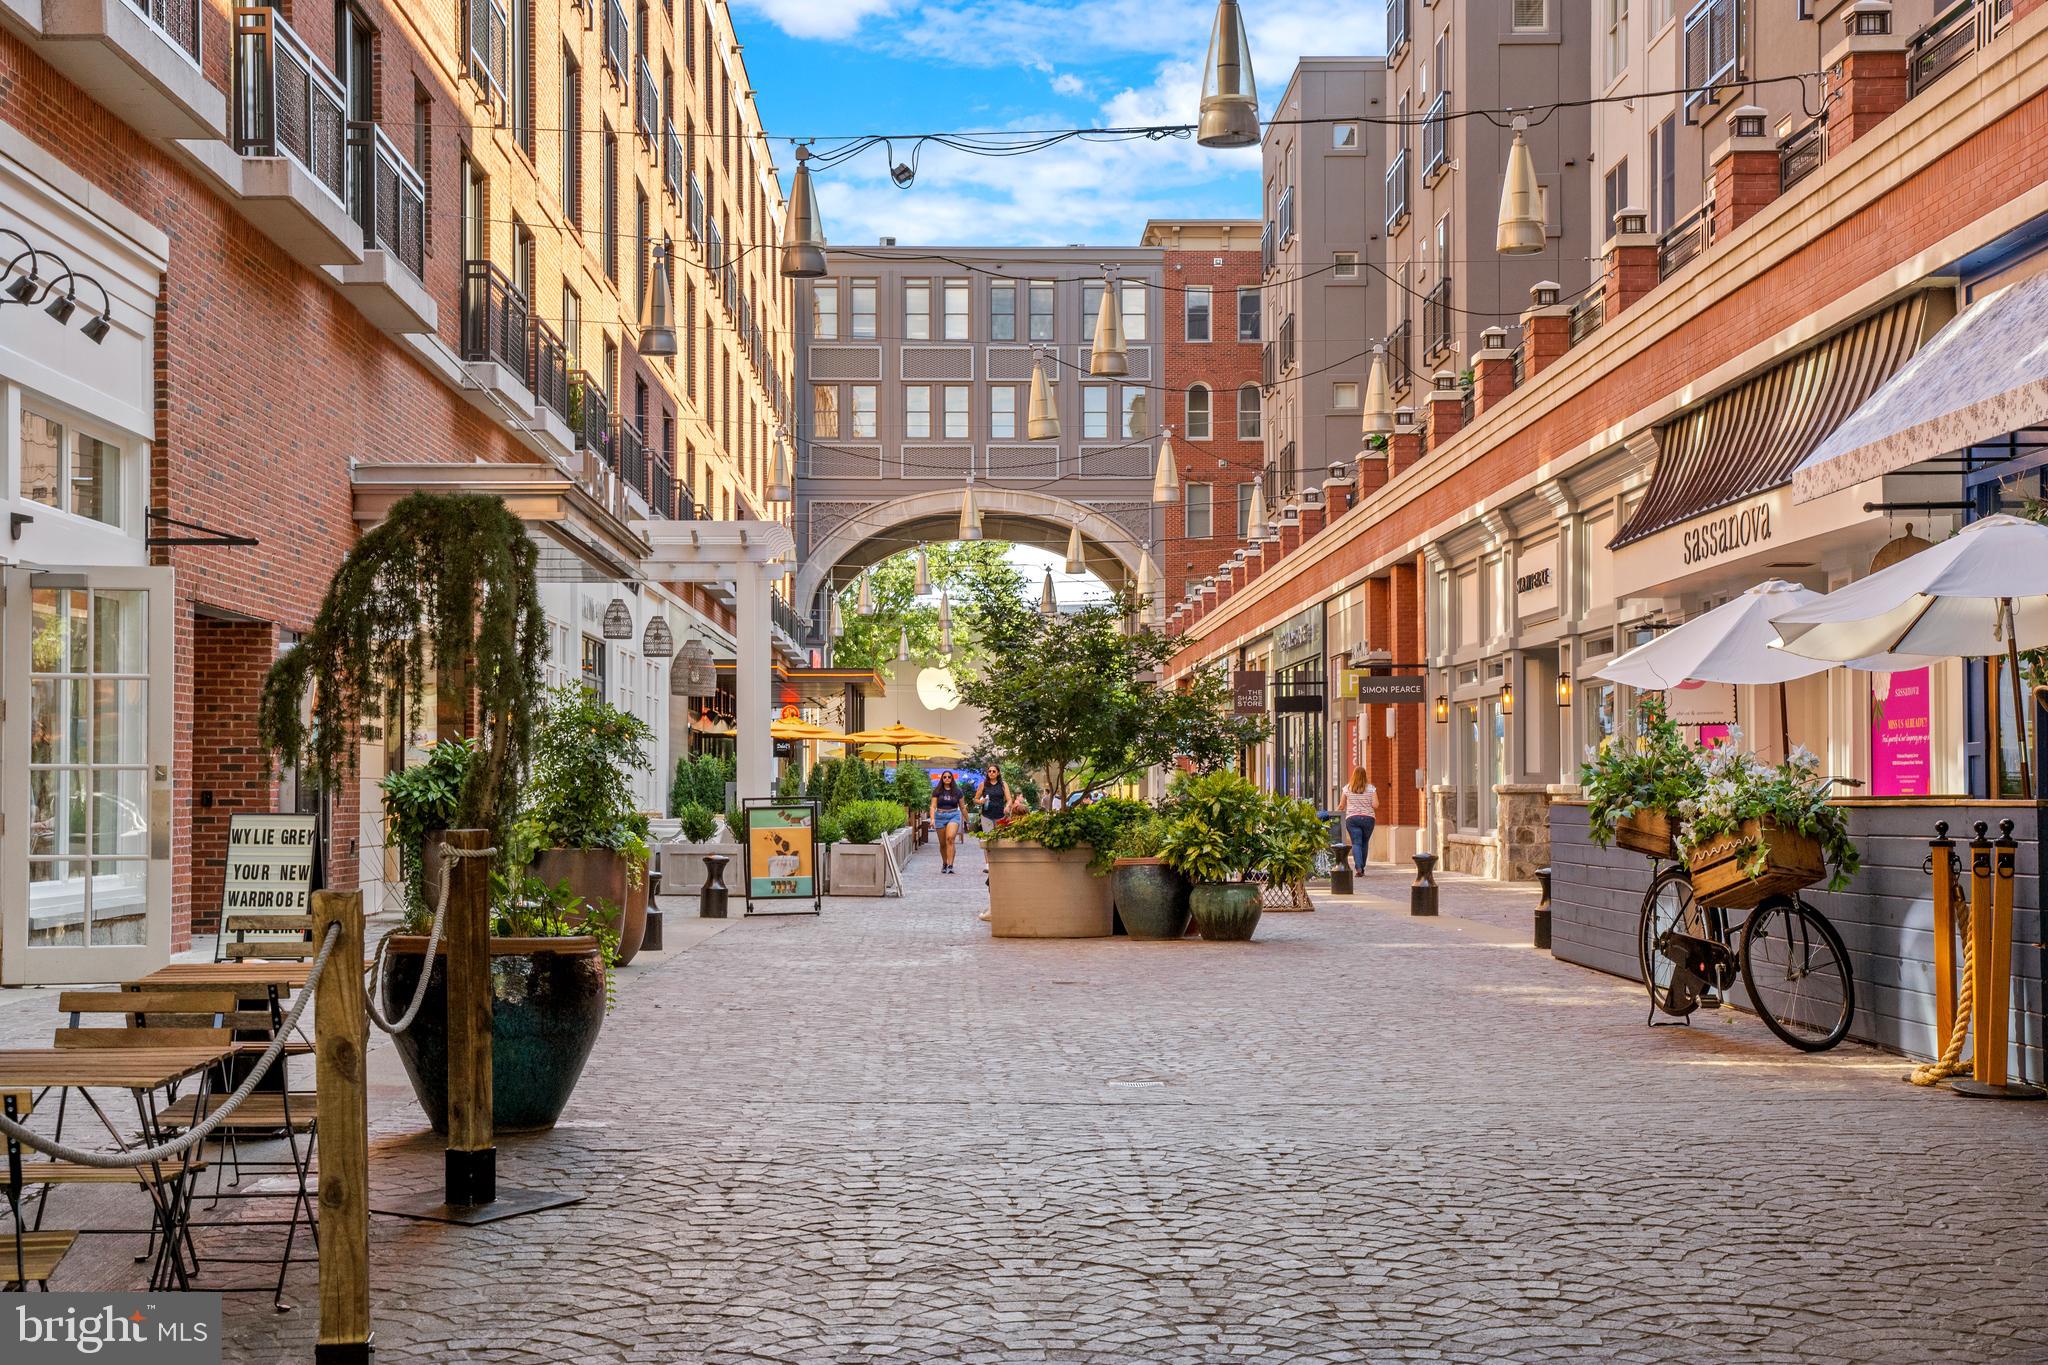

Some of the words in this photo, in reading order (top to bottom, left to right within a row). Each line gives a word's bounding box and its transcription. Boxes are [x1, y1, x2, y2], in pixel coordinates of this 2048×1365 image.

[1684, 503, 1771, 565] sassanova
[1362, 686, 1388, 694] SIMON
[1390, 685, 1421, 693] PEARCE
[231, 828, 275, 845] WYLIE
[281, 829, 315, 845] GREY
[233, 864, 270, 880] YOUR
[280, 864, 310, 881] NEW
[228, 890, 305, 907] WARDROBE
